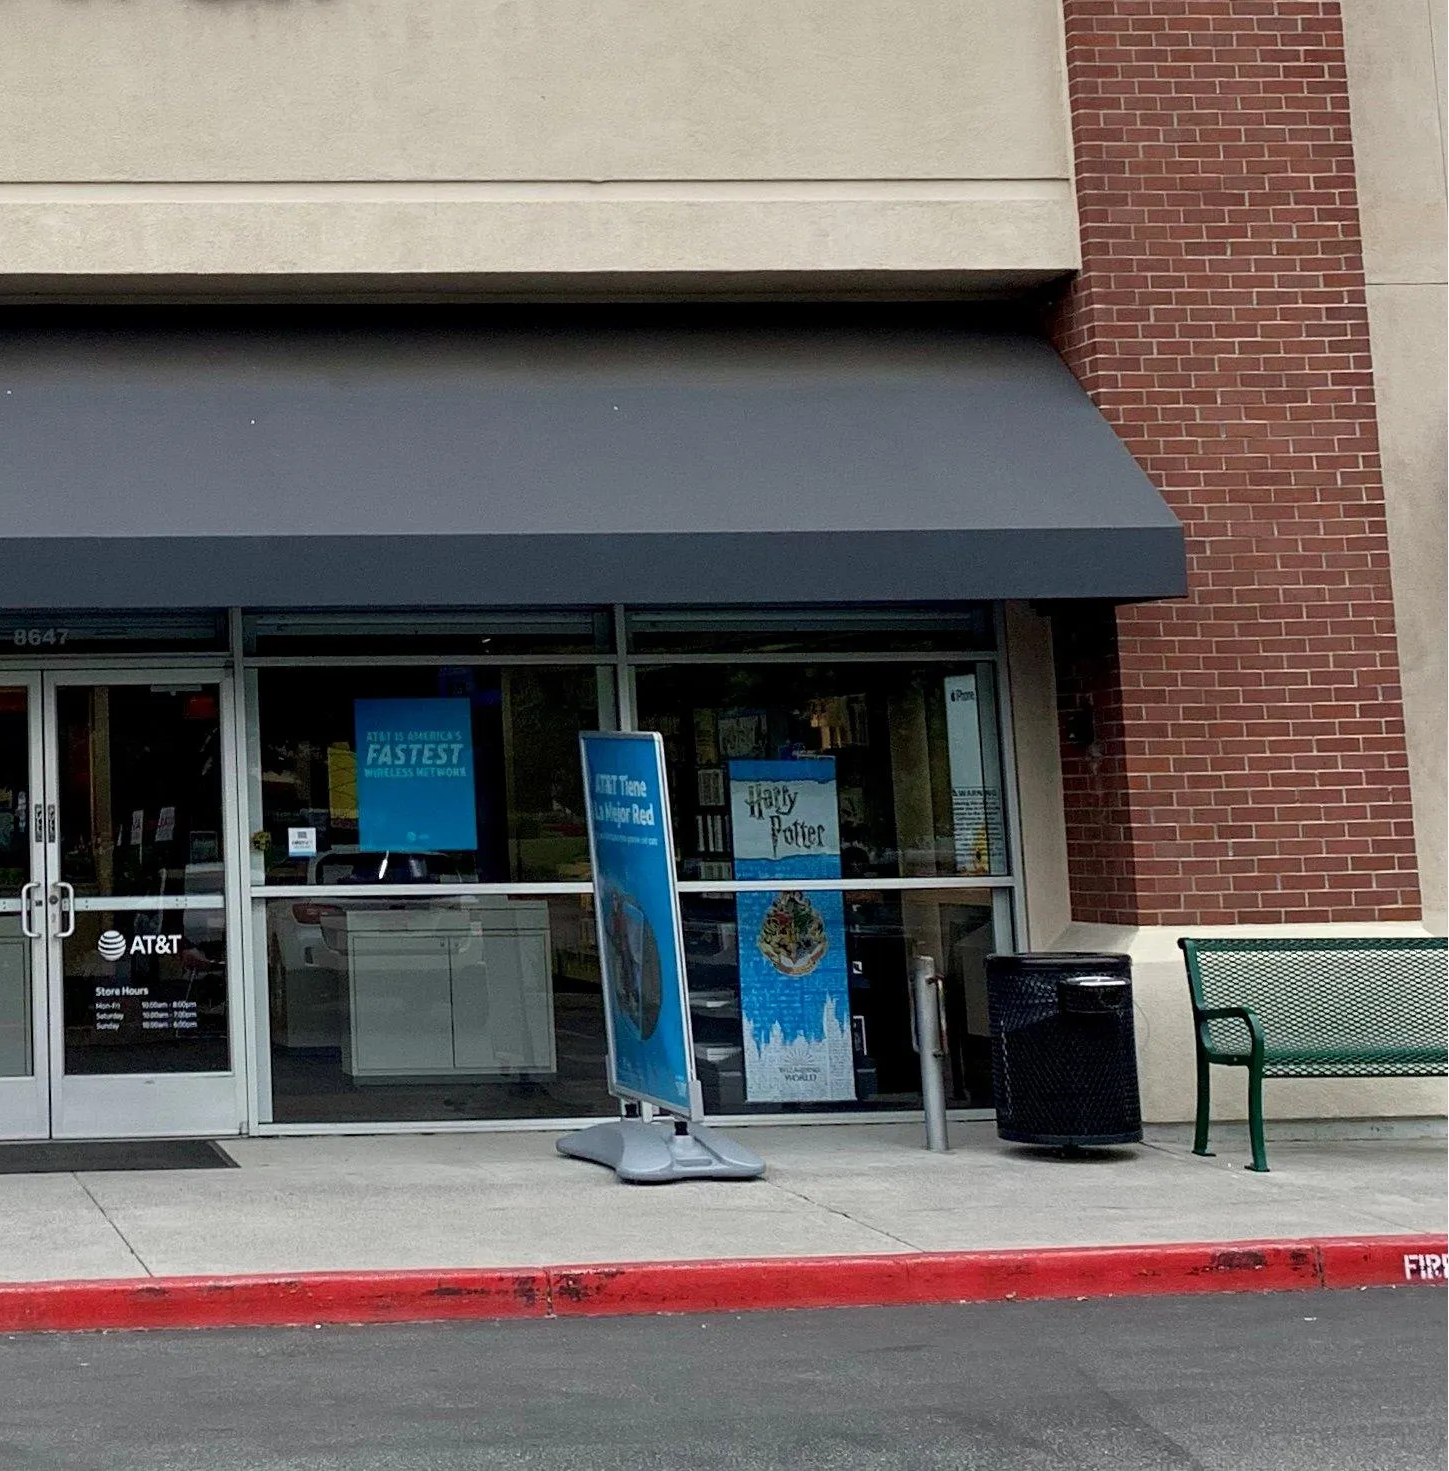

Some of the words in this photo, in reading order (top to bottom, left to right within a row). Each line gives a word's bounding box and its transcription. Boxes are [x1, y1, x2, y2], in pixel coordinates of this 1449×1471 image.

[13, 628, 69, 646] 8647
[366, 731, 391, 742] AT&T
[395, 731, 404, 742] IS
[407, 731, 462, 742] AMERICA'S
[366, 743, 464, 765] FASTEST
[364, 767, 414, 778] WIRELESS
[416, 767, 467, 777] NETWORK
[595, 773, 617, 796] AT&T
[619, 774, 647, 798] Tiene
[958, 789, 997, 797] WARNNG
[745, 783, 798, 820] Harry
[591, 801, 604, 821] La
[605, 801, 630, 828] Mejor
[632, 802, 655, 826] Red
[769, 815, 825, 859] Potter
[129, 934, 182, 955] AT&T
[95, 987, 120, 996] Store
[122, 986, 149, 996] Hours
[95, 1001, 121, 1009] Mon-Fri
[96, 1012, 124, 1020] Saturday
[96, 1022, 120, 1030] Sunday
